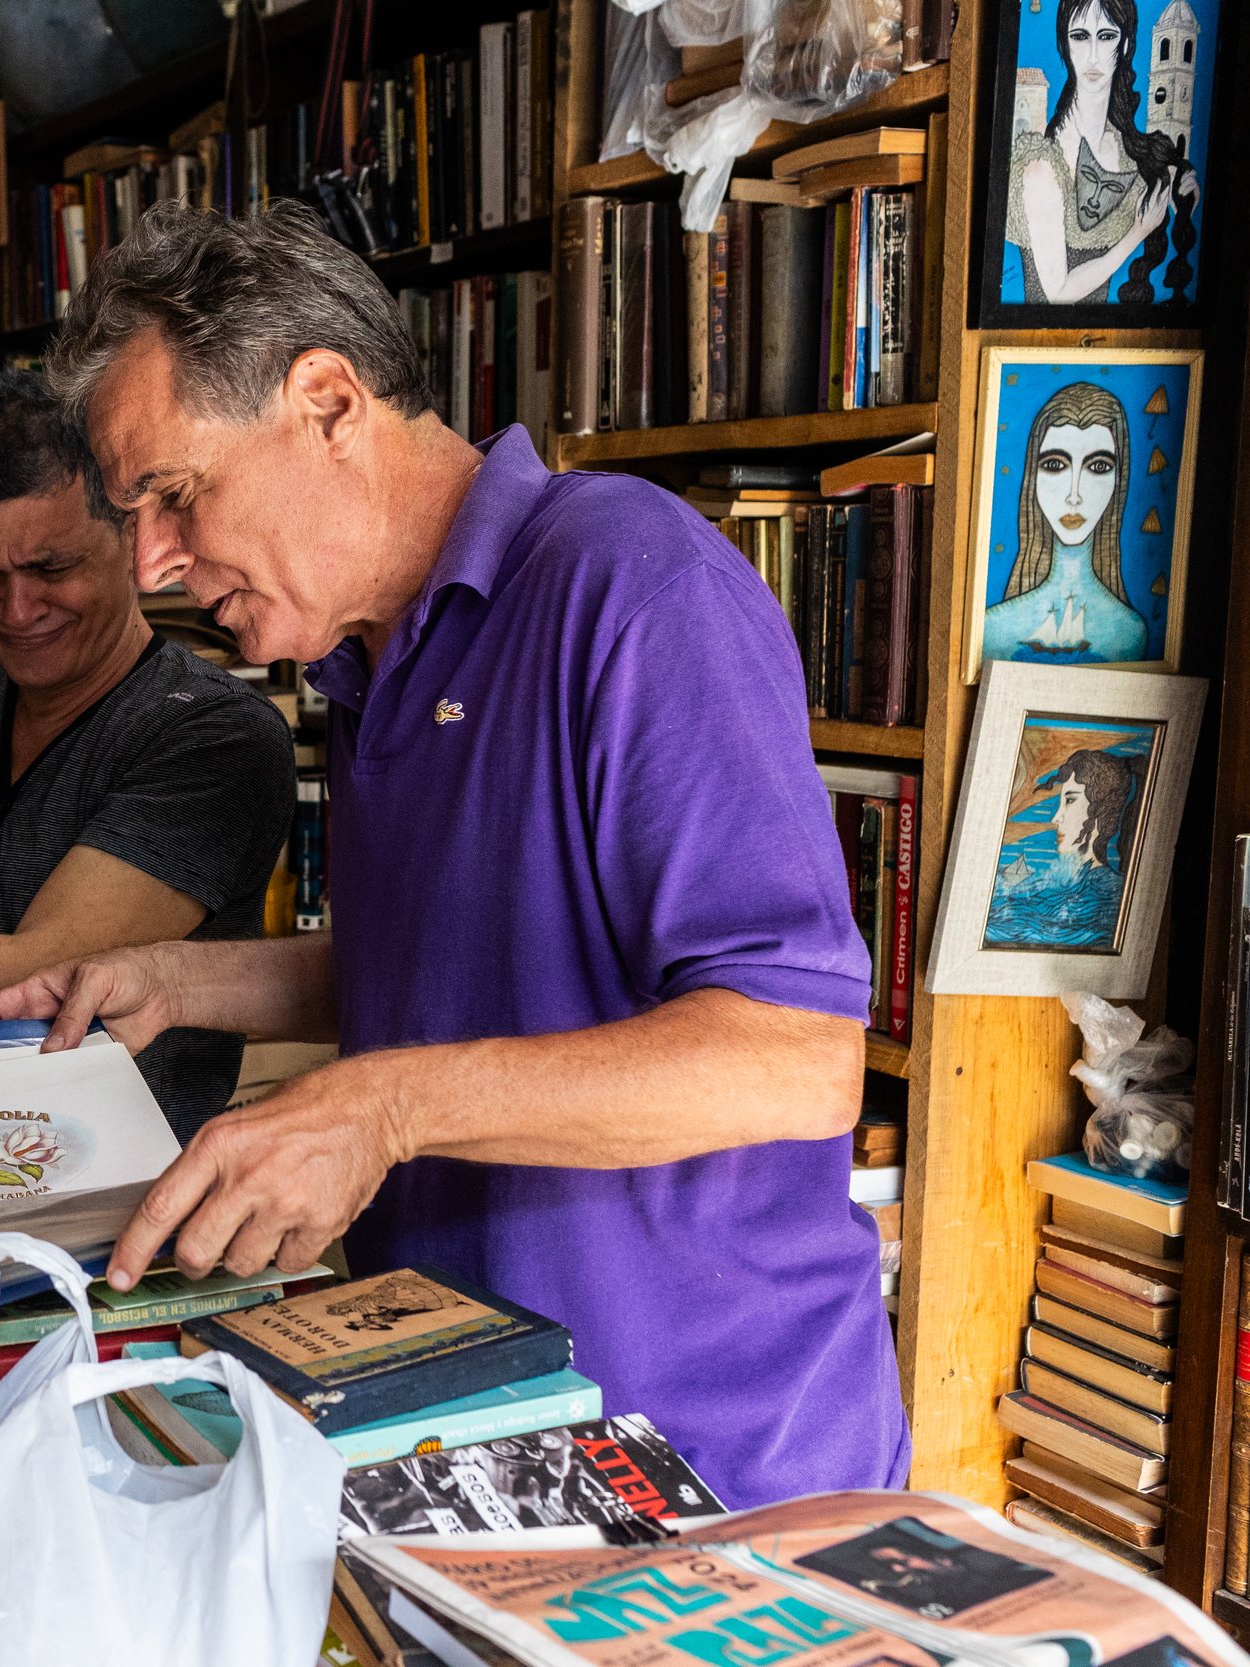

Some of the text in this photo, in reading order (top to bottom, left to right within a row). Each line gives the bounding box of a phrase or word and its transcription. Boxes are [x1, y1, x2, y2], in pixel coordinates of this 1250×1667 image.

[897, 803, 912, 890] CASTIGO
[895, 911, 908, 985] Crimen
[151, 1305, 166, 1316] EL
[169, 1303, 186, 1314] EN
[190, 1296, 238, 1313] LATINOS
[270, 1301, 350, 1350] DOROTE
[261, 1318, 327, 1355] HERMAN
[573, 1437, 680, 1520] NELLY
